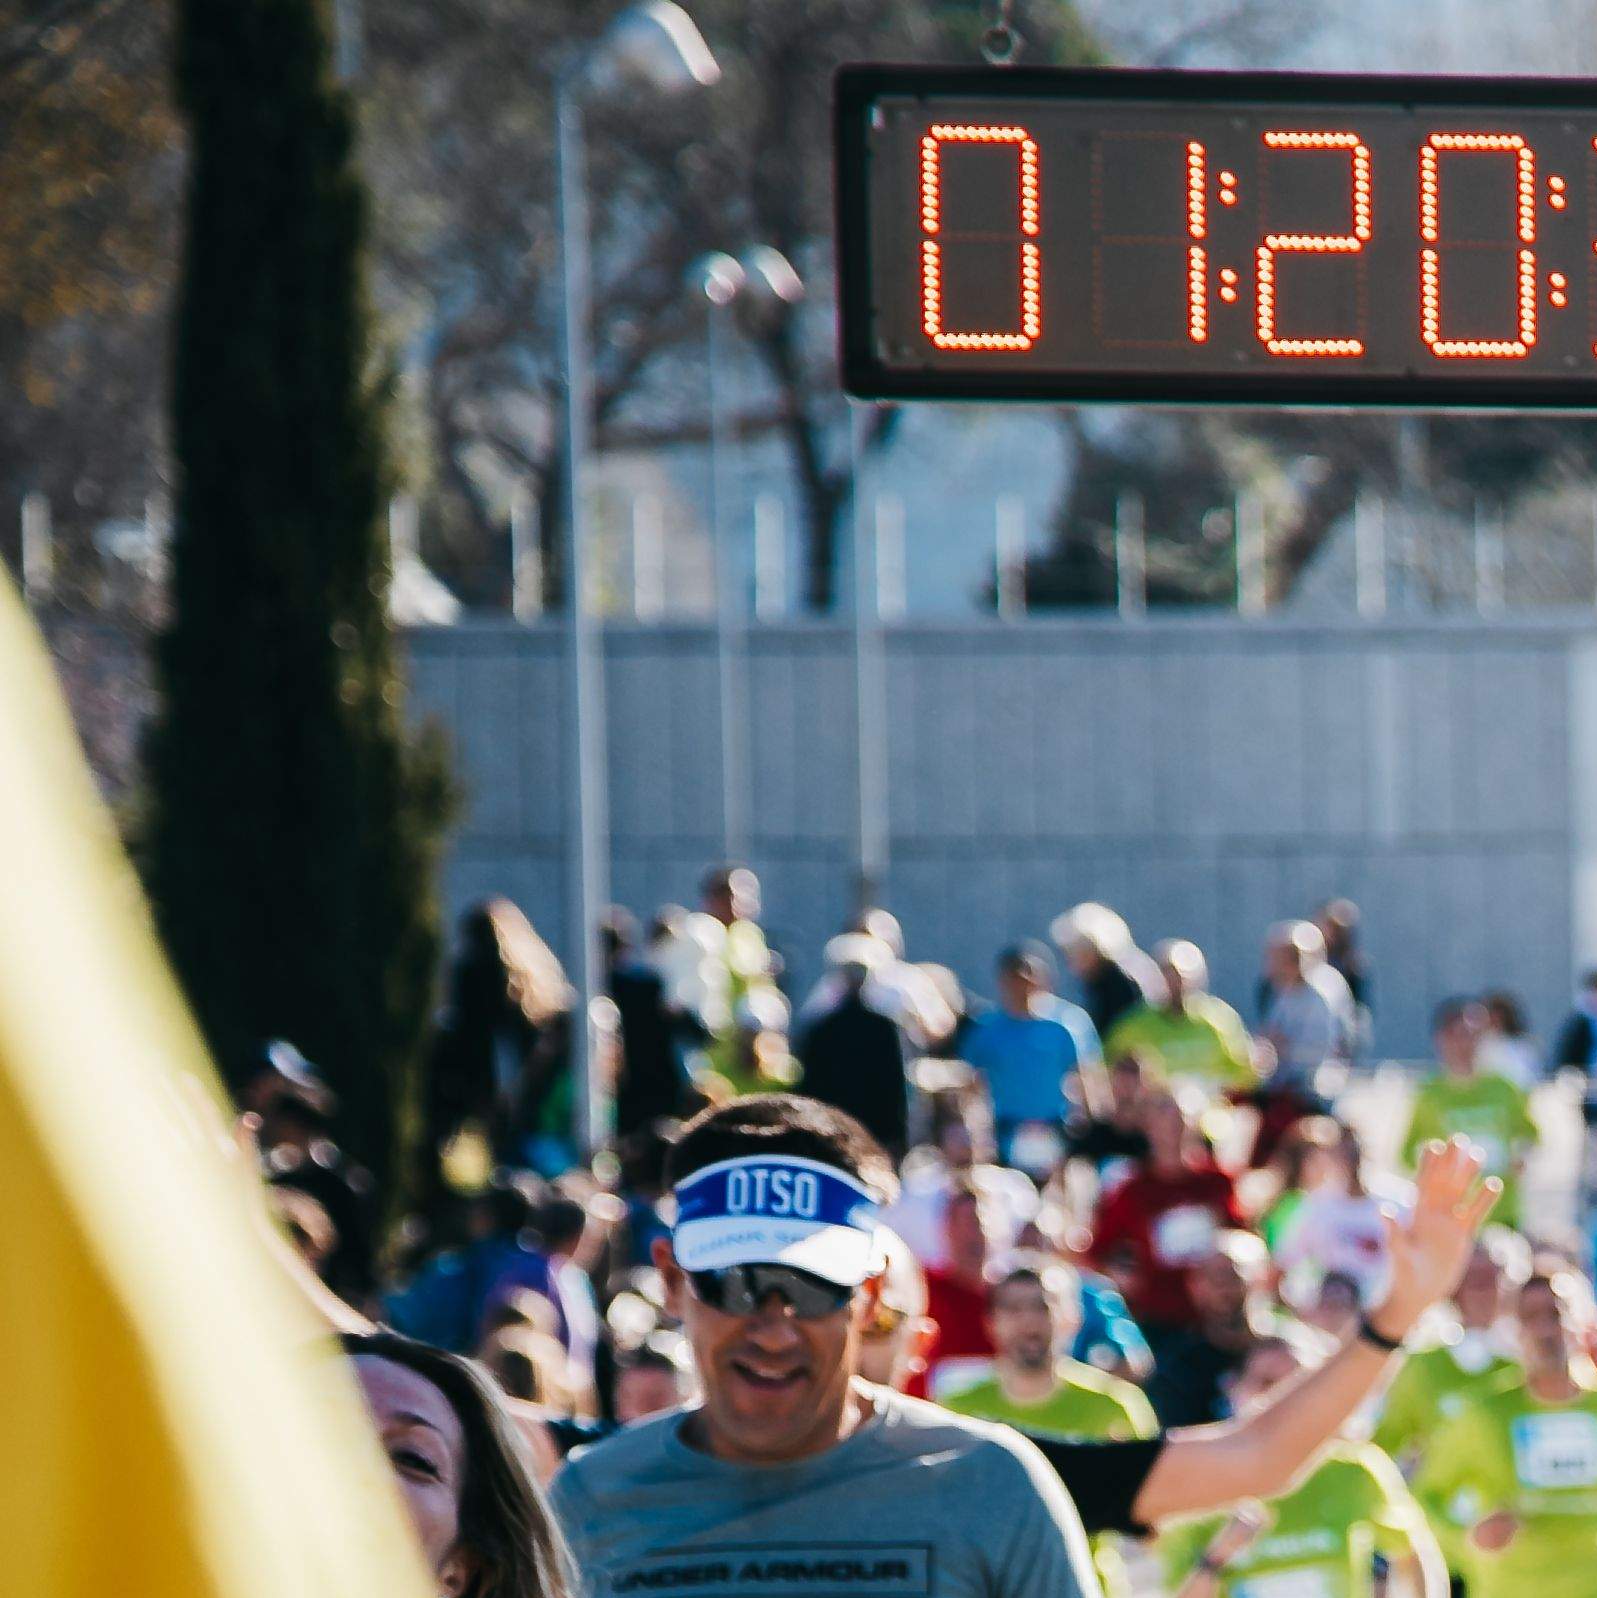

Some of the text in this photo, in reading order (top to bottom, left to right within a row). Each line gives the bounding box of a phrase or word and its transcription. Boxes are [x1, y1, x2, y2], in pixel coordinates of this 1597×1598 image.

[727, 1169, 818, 1217] OTSO
[611, 1560, 908, 1593] UNDER ARMOUR
